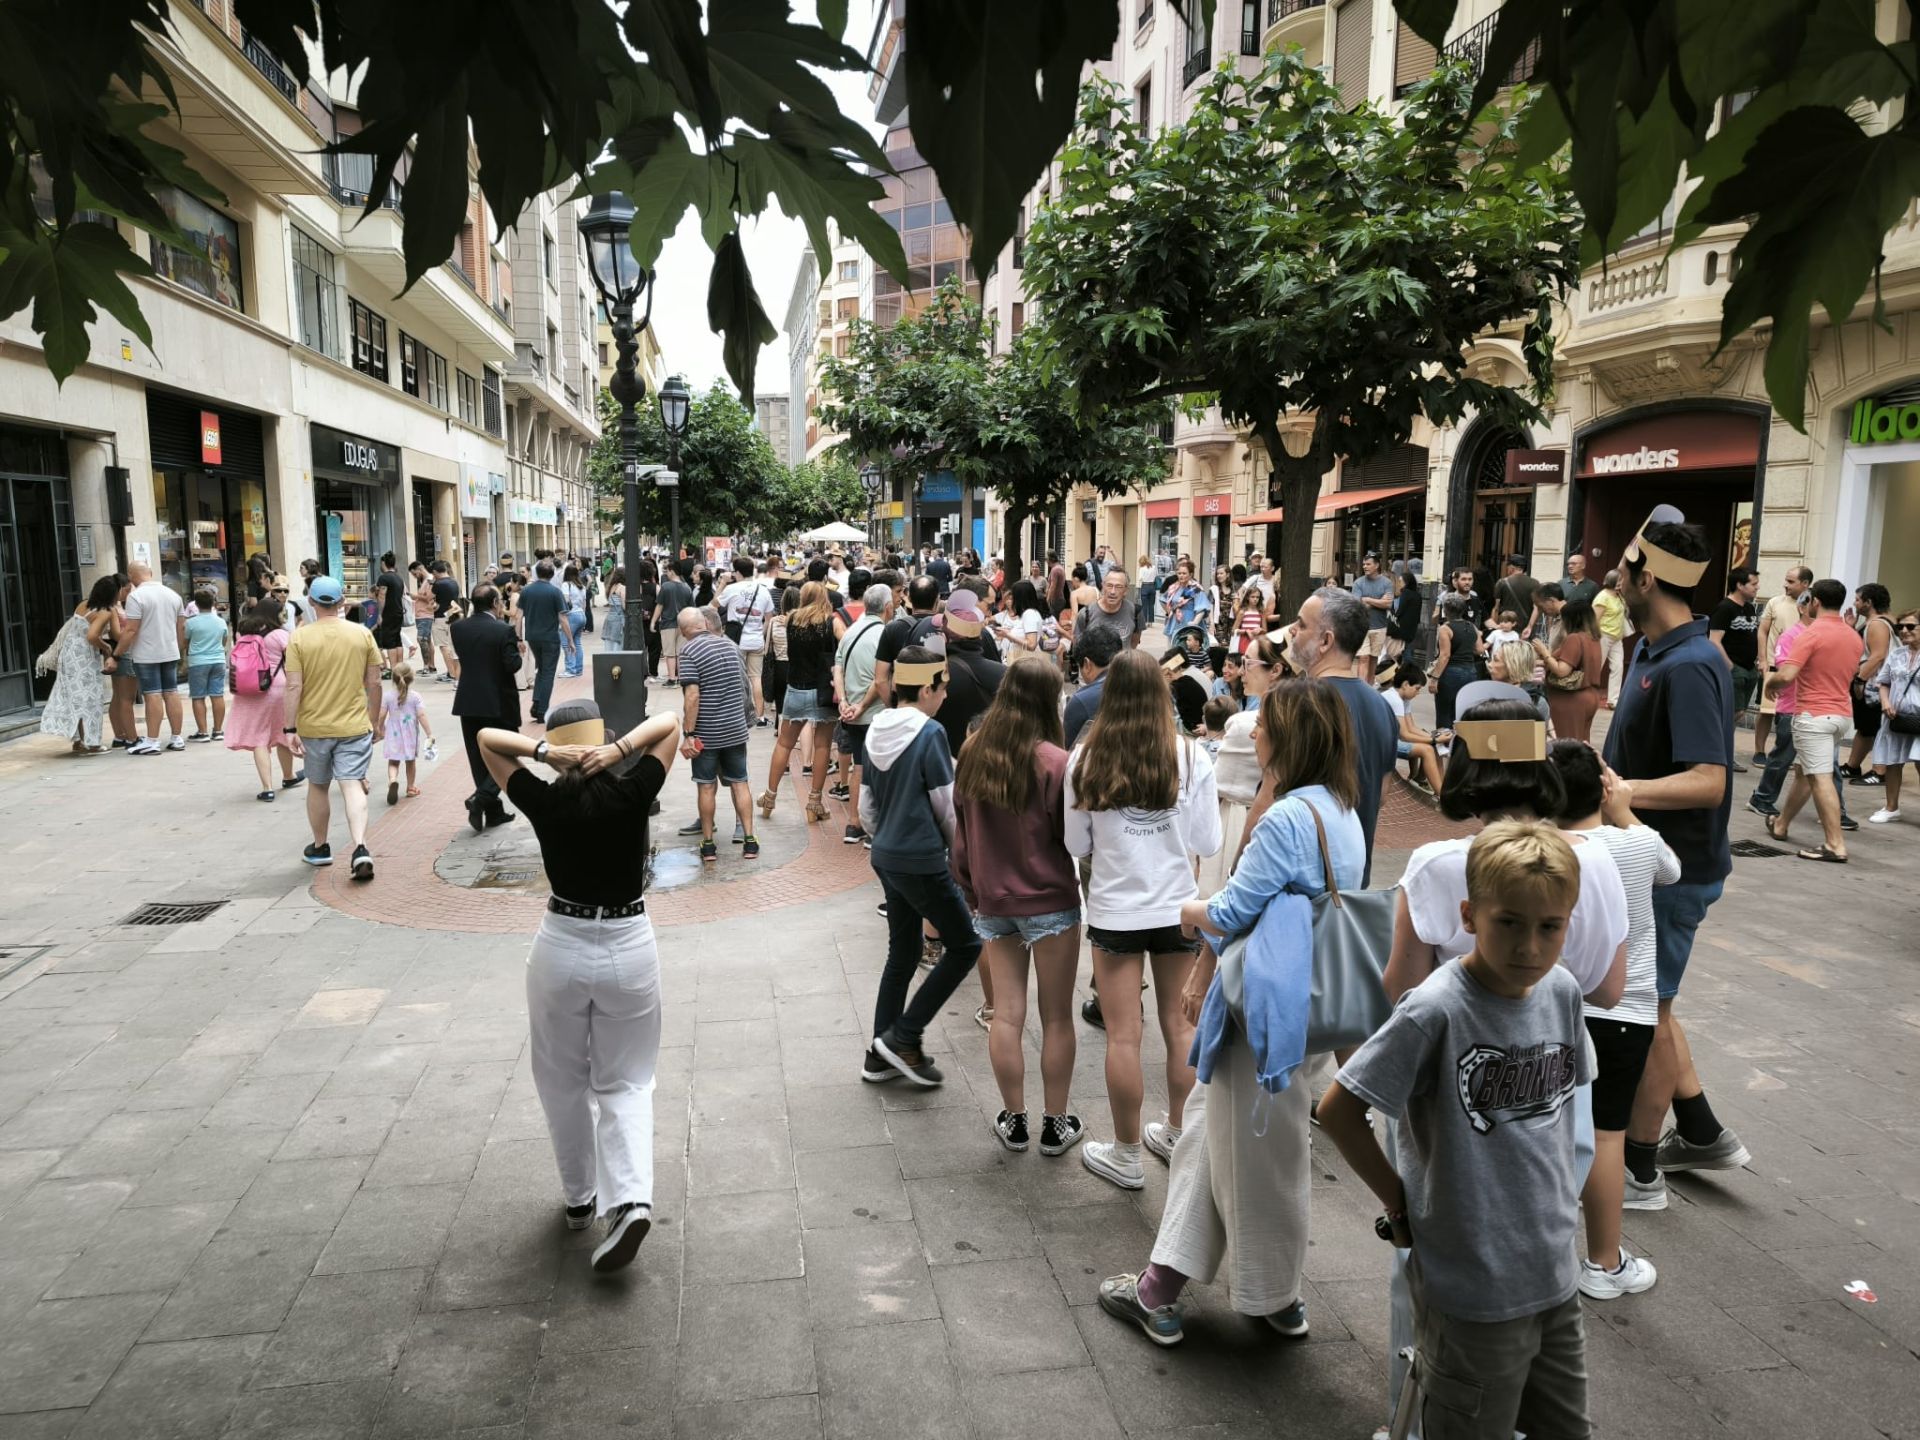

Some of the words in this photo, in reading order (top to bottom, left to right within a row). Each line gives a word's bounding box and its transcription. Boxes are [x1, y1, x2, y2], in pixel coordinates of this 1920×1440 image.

[344, 441, 377, 471] DOUGLAS
[1519, 462, 1559, 471] wonders
[1593, 446, 1679, 474] wonders
[1204, 498, 1219, 512] GAES
[1123, 826, 1154, 836] SOUTH
[1157, 823, 1171, 833] BAY
[1470, 1046, 1576, 1111] BRONCS
